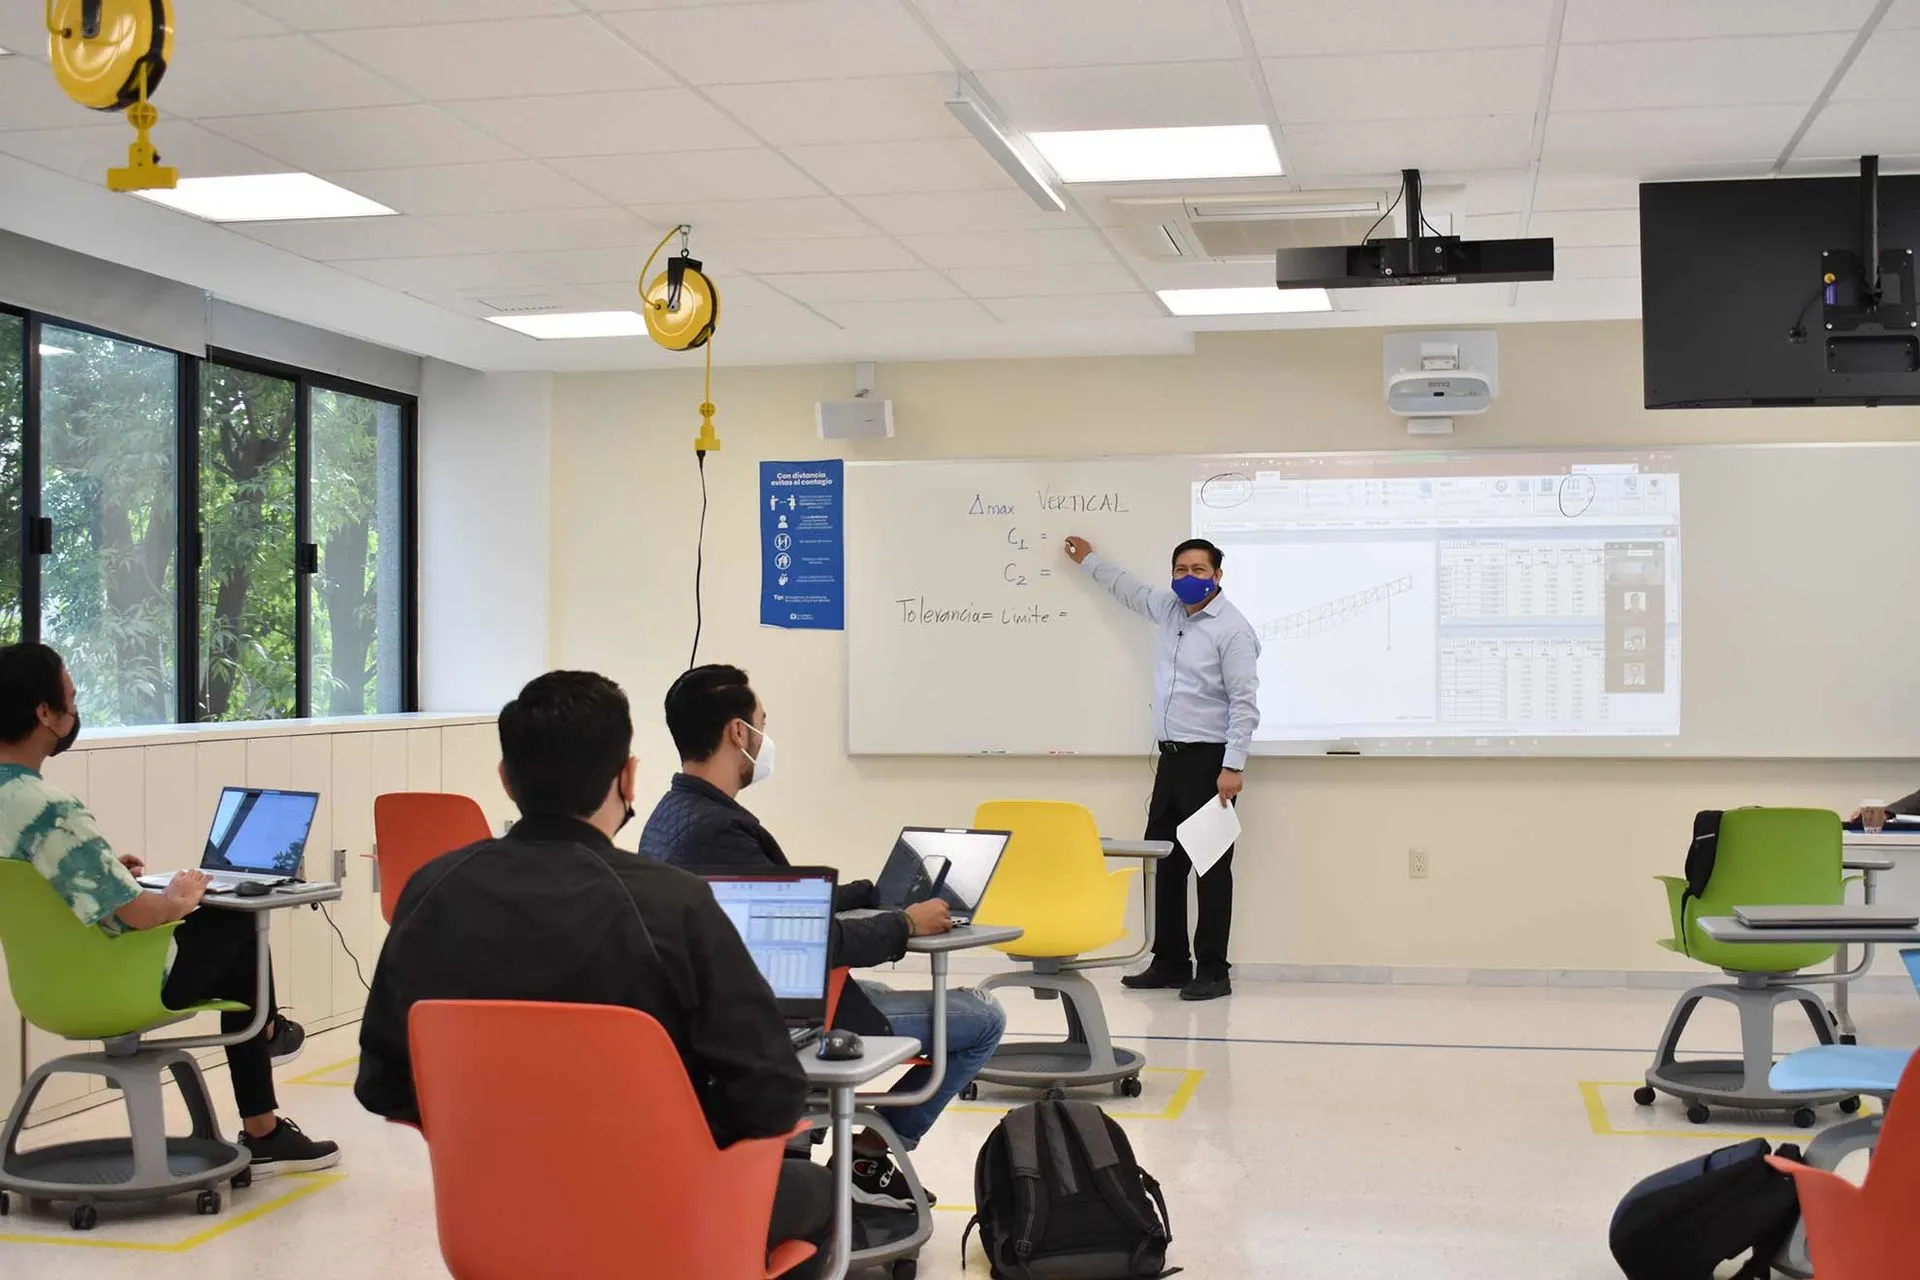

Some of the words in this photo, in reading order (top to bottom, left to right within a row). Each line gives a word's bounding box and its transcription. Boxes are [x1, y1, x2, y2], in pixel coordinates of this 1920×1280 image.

[792, 471, 826, 479] distancia
[801, 478, 833, 487] contagio
[1037, 484, 1129, 513] VERTICAL
